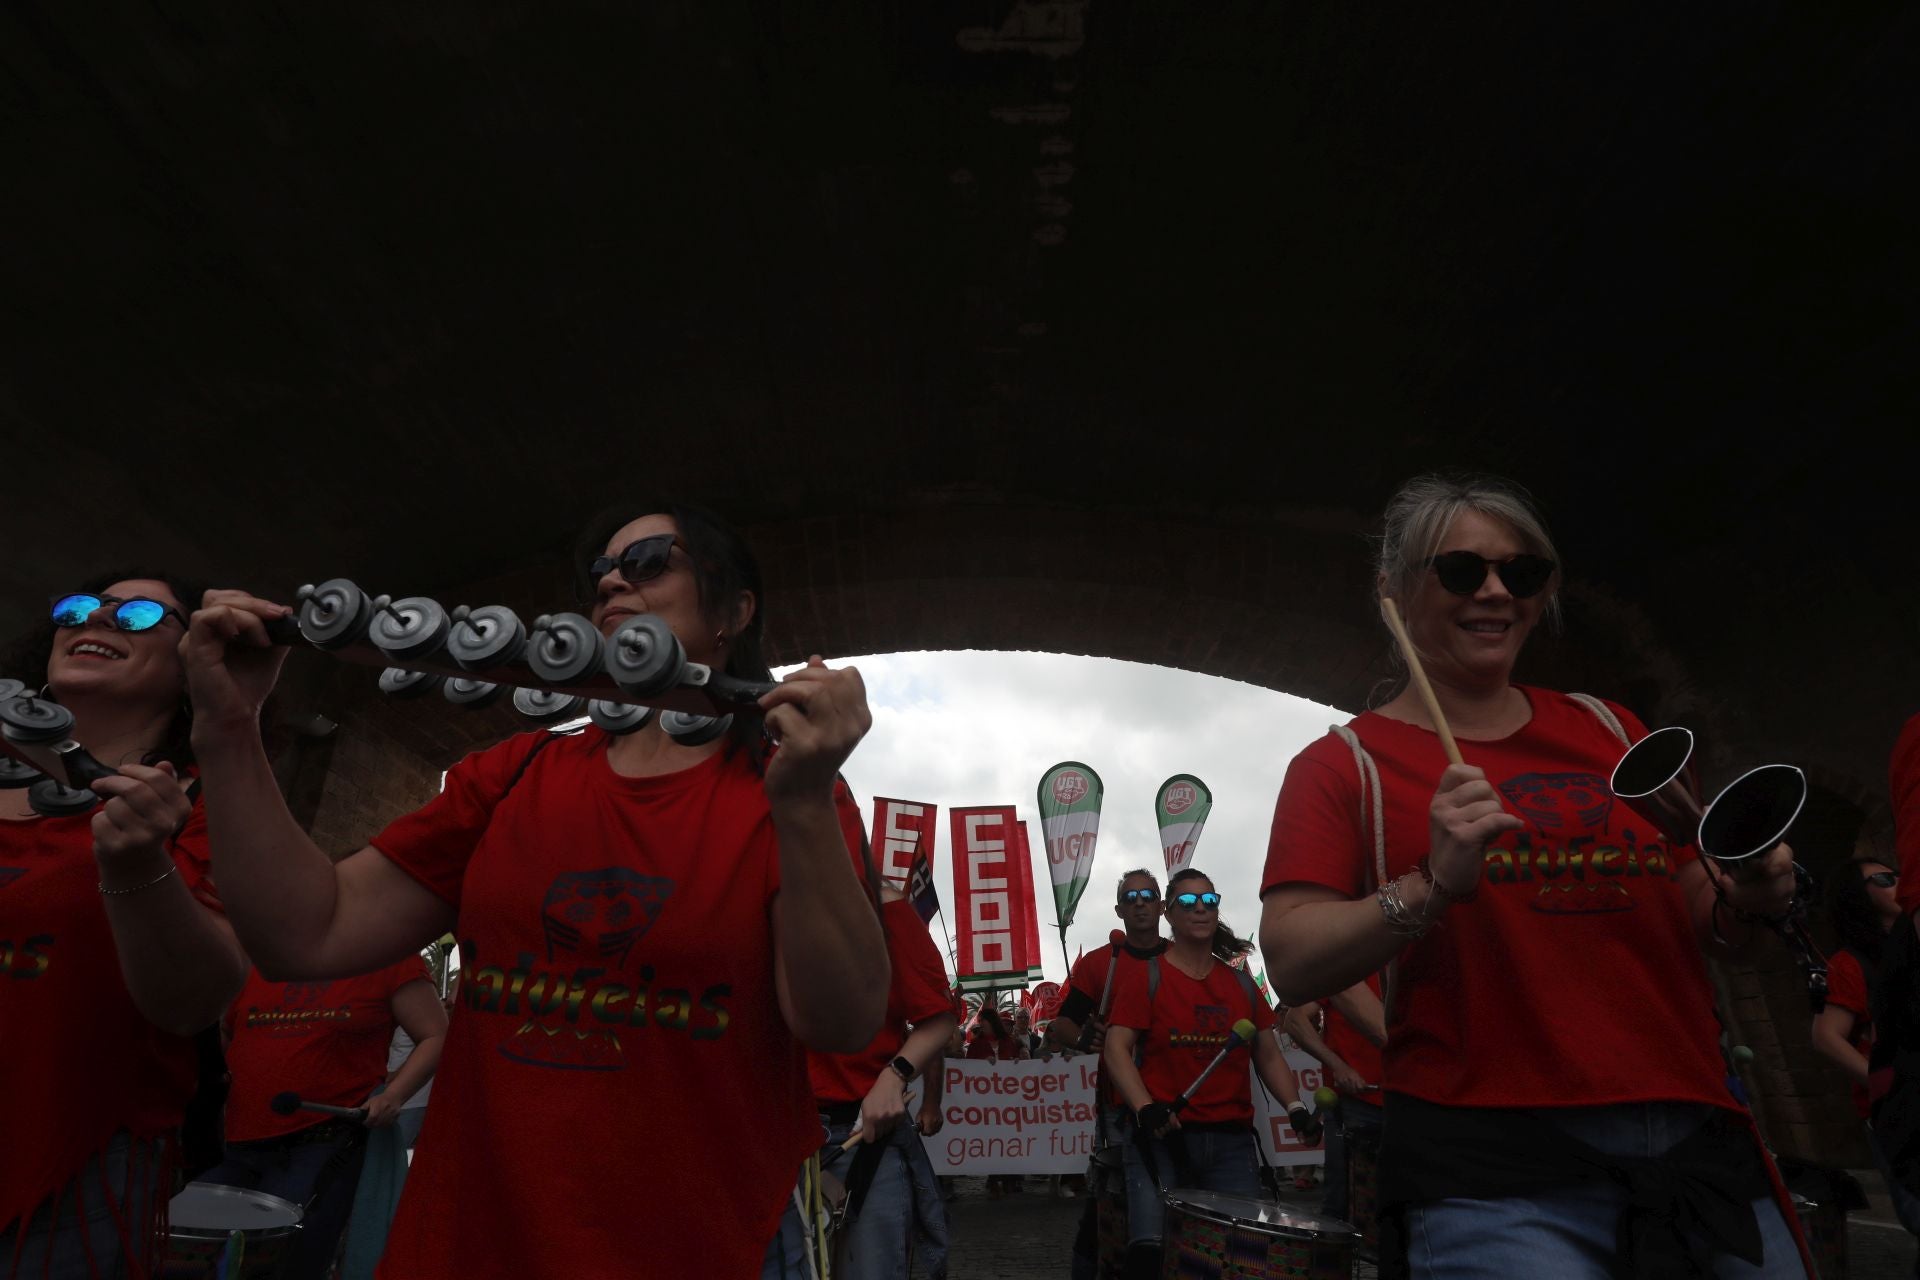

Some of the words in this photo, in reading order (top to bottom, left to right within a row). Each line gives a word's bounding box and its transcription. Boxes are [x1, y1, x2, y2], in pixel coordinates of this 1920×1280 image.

[1056, 776, 1084, 790] UGT
[1167, 787, 1192, 800] UGT
[1049, 833, 1096, 864] UGT
[965, 814, 1013, 973] CCOO
[945, 1067, 1070, 1101] Proteger
[946, 1135, 1037, 1166] ganar
